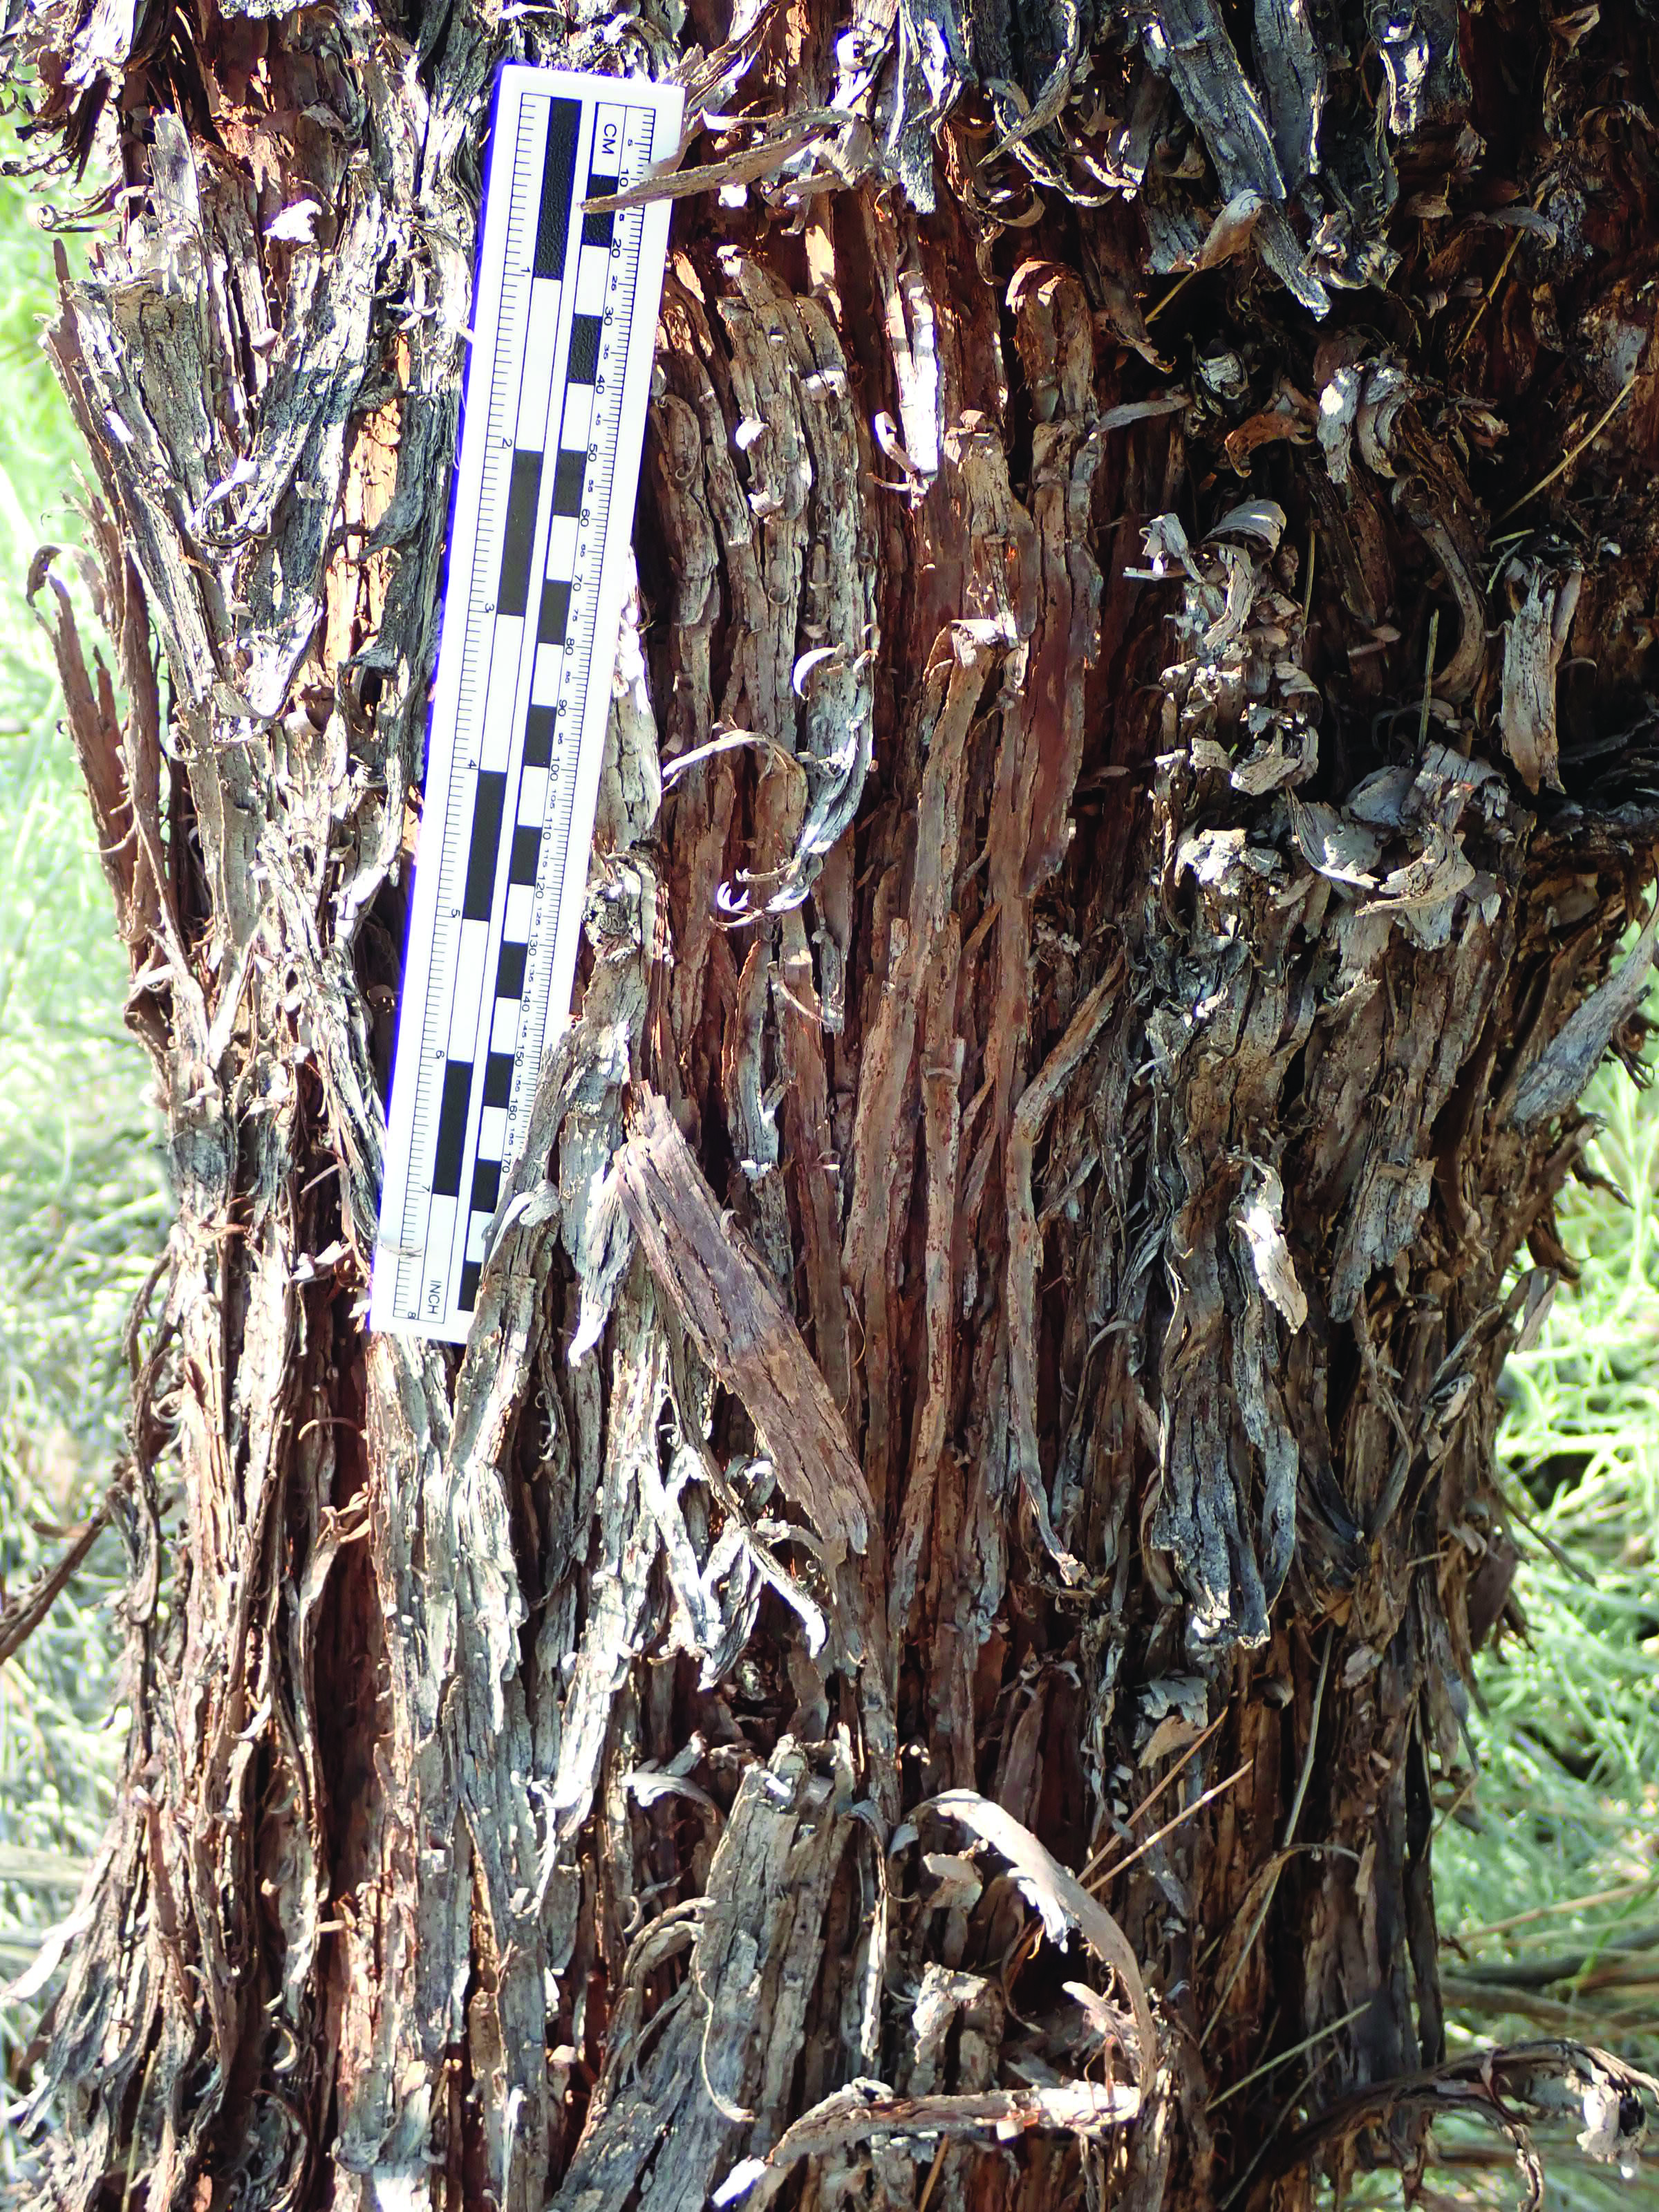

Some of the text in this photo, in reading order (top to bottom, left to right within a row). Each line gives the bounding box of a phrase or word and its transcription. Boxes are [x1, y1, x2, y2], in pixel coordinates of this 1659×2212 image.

[602, 124, 617, 154] CM
[627, 138, 633, 147] 5
[619, 168, 629, 187] 10
[611, 238, 621, 259] 20
[611, 275, 618, 291] 25
[603, 306, 614, 326] 30
[603, 344, 610, 359] 35
[596, 374, 606, 395] 40
[595, 413, 601, 426] 45
[502, 437, 513, 449] 2
[588, 443, 598, 462] 50
[588, 479, 594, 493] 55
[580, 508, 590, 527] 60
[572, 574, 583, 592] 70
[485, 602, 495, 613] 3
[572, 608, 579, 622] 75
[565, 637, 575, 656] 80
[557, 699, 568, 717] 90
[467, 758, 477, 769] 4
[550, 756, 560, 781] 100
[543, 816, 553, 841] 110
[535, 875, 545, 899] 120
[451, 908, 460, 918] 5
[528, 932, 538, 957] 130
[521, 989, 532, 1013] 140
[435, 1049, 445, 1059] 6
[515, 1044, 525, 1067] 150
[508, 1098, 518, 1121] 160
[502, 1152, 512, 1173] 170
[427, 1280, 442, 1315] INCH
[407, 1311, 416, 1320] 8
